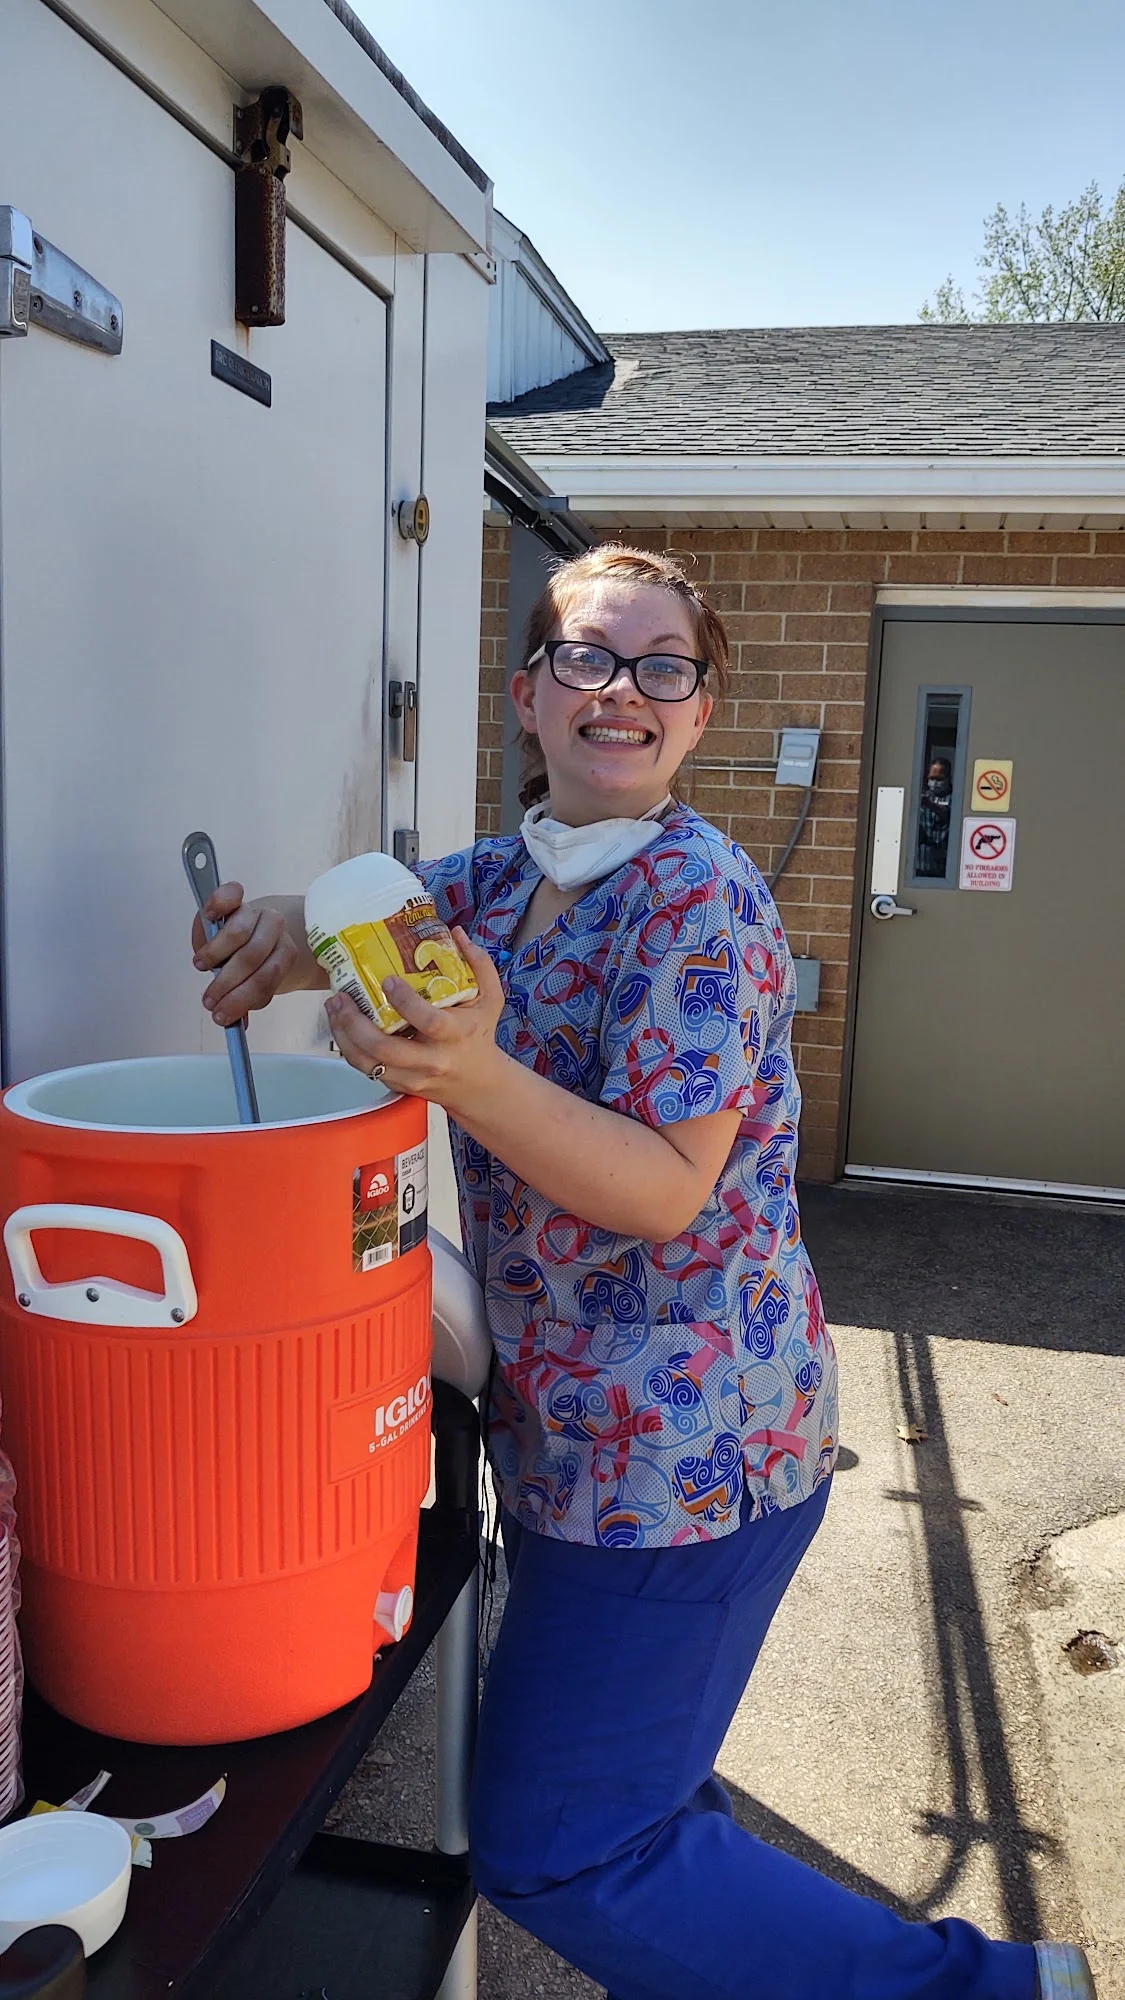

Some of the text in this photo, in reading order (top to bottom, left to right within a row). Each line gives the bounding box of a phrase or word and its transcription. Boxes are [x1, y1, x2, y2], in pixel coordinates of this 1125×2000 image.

[976, 864, 1009, 872] FIREARMS
[367, 1185, 390, 1199] IGLOO
[369, 1429, 398, 1453] 5-GAL
